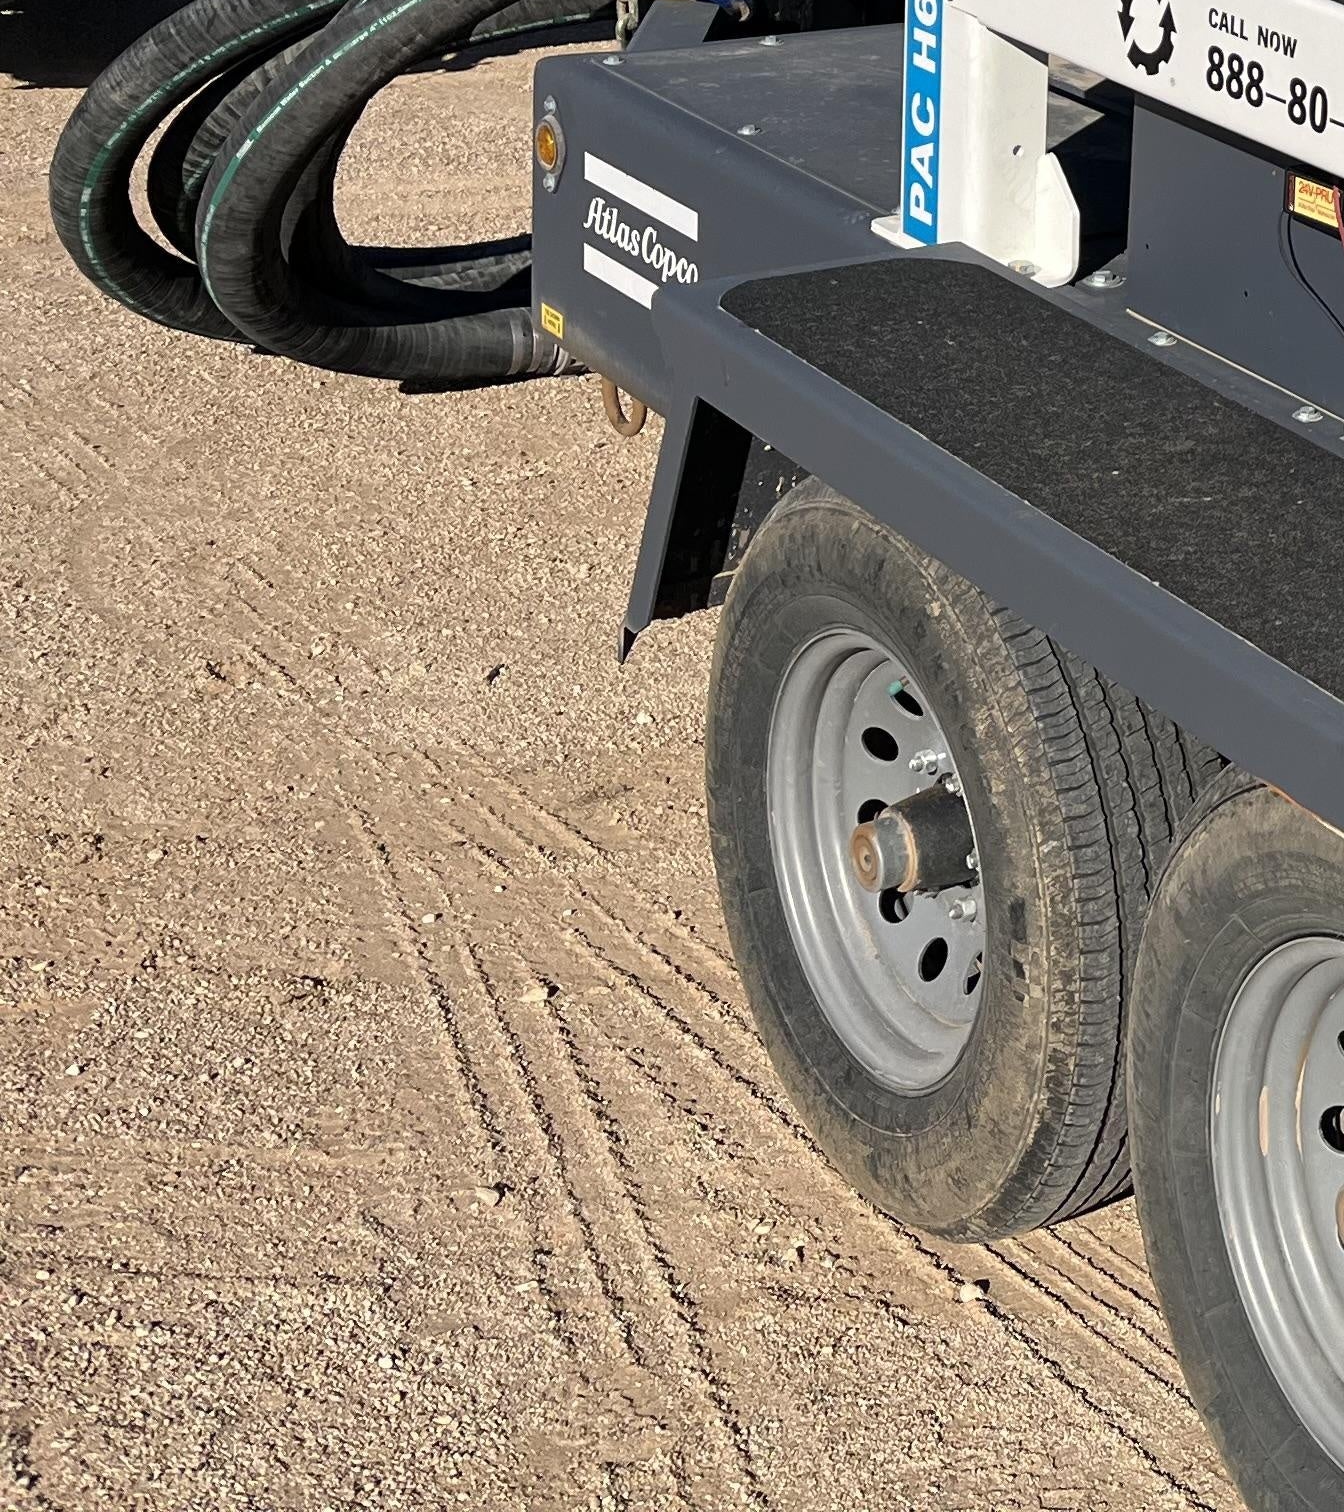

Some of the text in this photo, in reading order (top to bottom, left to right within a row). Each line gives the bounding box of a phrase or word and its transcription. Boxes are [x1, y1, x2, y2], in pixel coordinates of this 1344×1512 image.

[1208, 8, 1297, 59] CALL NOW
[909, 92, 935, 226] PAC
[583, 197, 640, 257] Atlas
